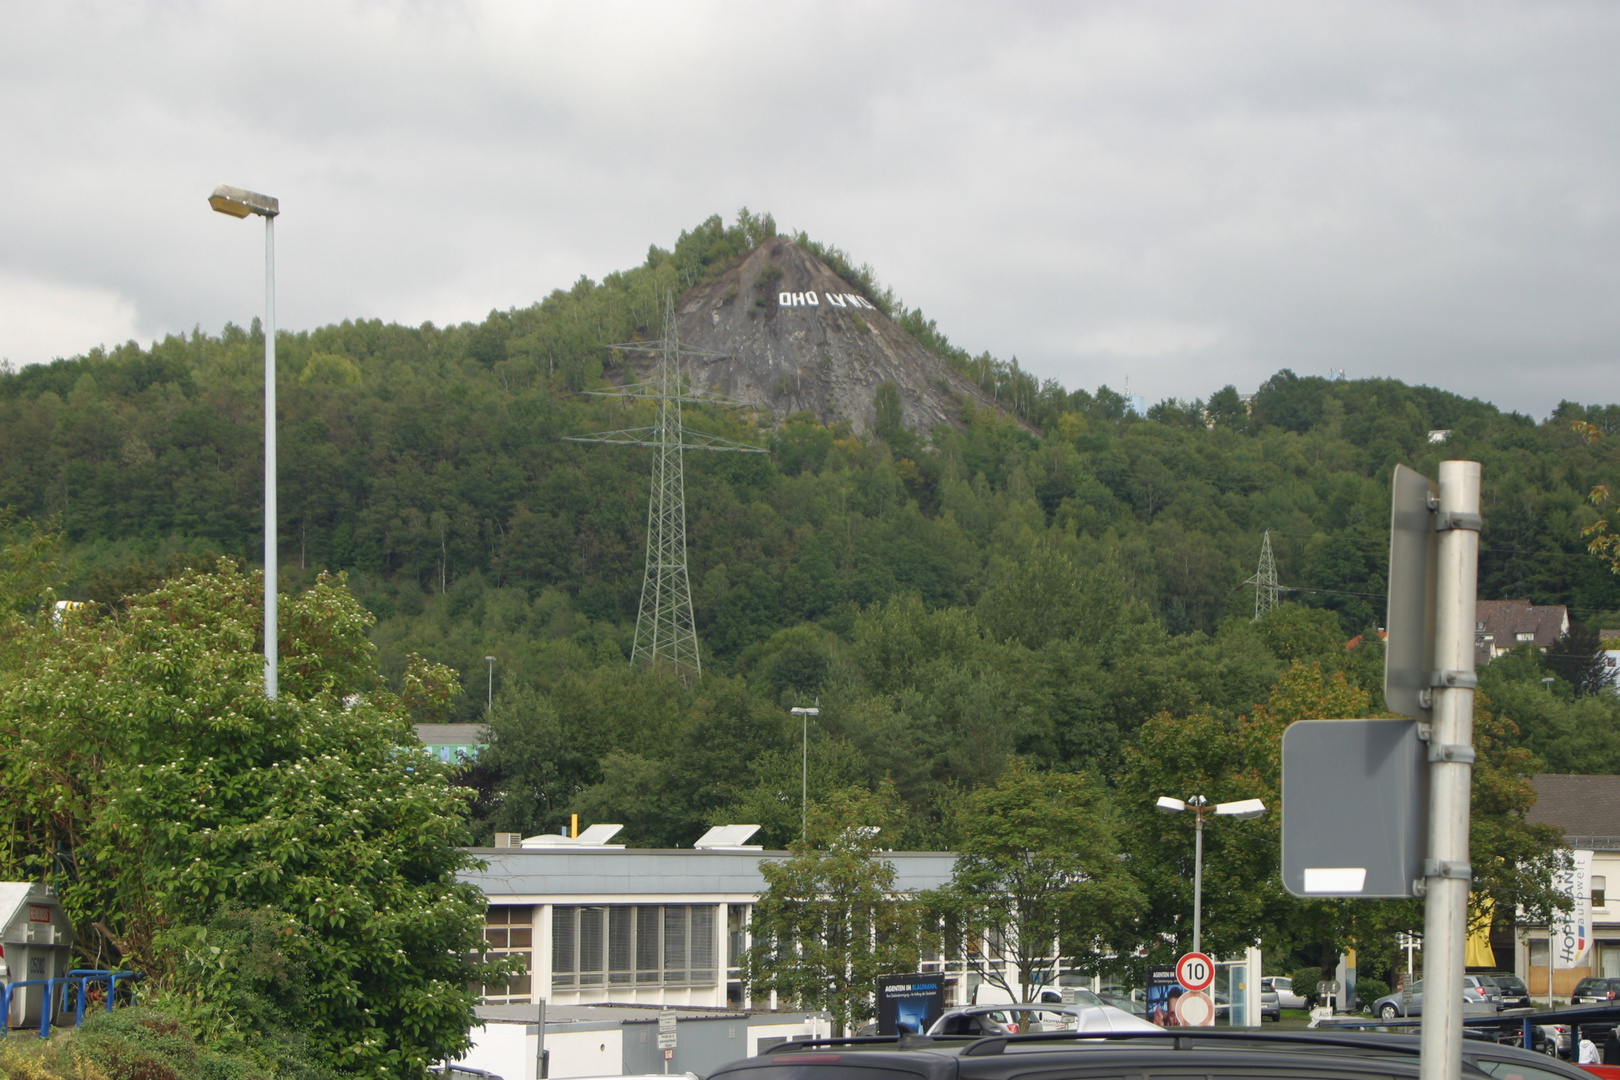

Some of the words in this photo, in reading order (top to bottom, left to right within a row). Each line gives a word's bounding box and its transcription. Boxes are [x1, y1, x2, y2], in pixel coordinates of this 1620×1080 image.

[1560, 864, 1575, 963] HOPPAN
[1576, 860, 1586, 925] autowelt
[1187, 963, 1205, 980] 10
